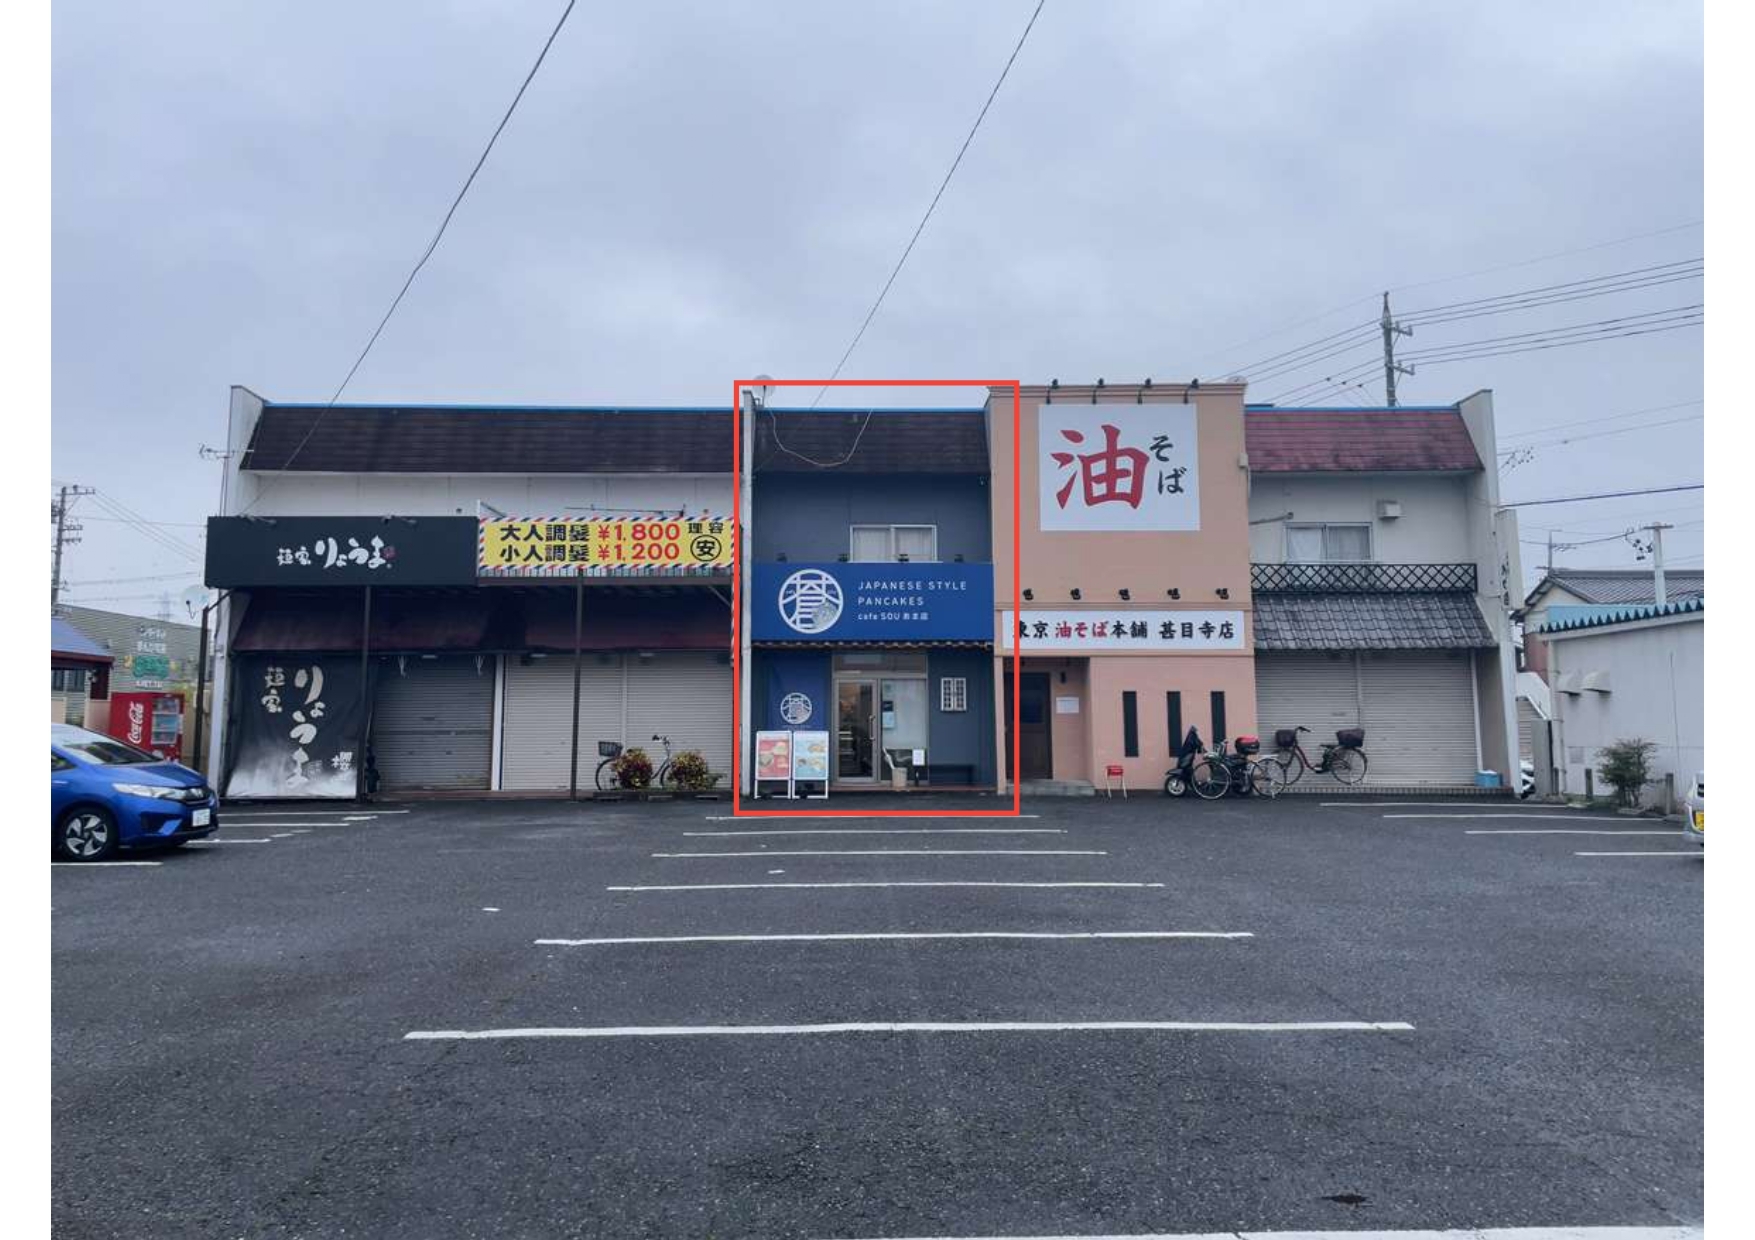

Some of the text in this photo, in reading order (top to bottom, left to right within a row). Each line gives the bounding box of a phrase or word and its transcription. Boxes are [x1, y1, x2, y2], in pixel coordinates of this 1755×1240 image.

[1050, 424, 1188, 509] 油 そば
[858, 580, 967, 591] JAPANESE STYLE
[858, 596, 924, 606] PANCAKES
[880, 611, 900, 620] SOU
[1158, 620, 1235, 639] 甚目寺店
